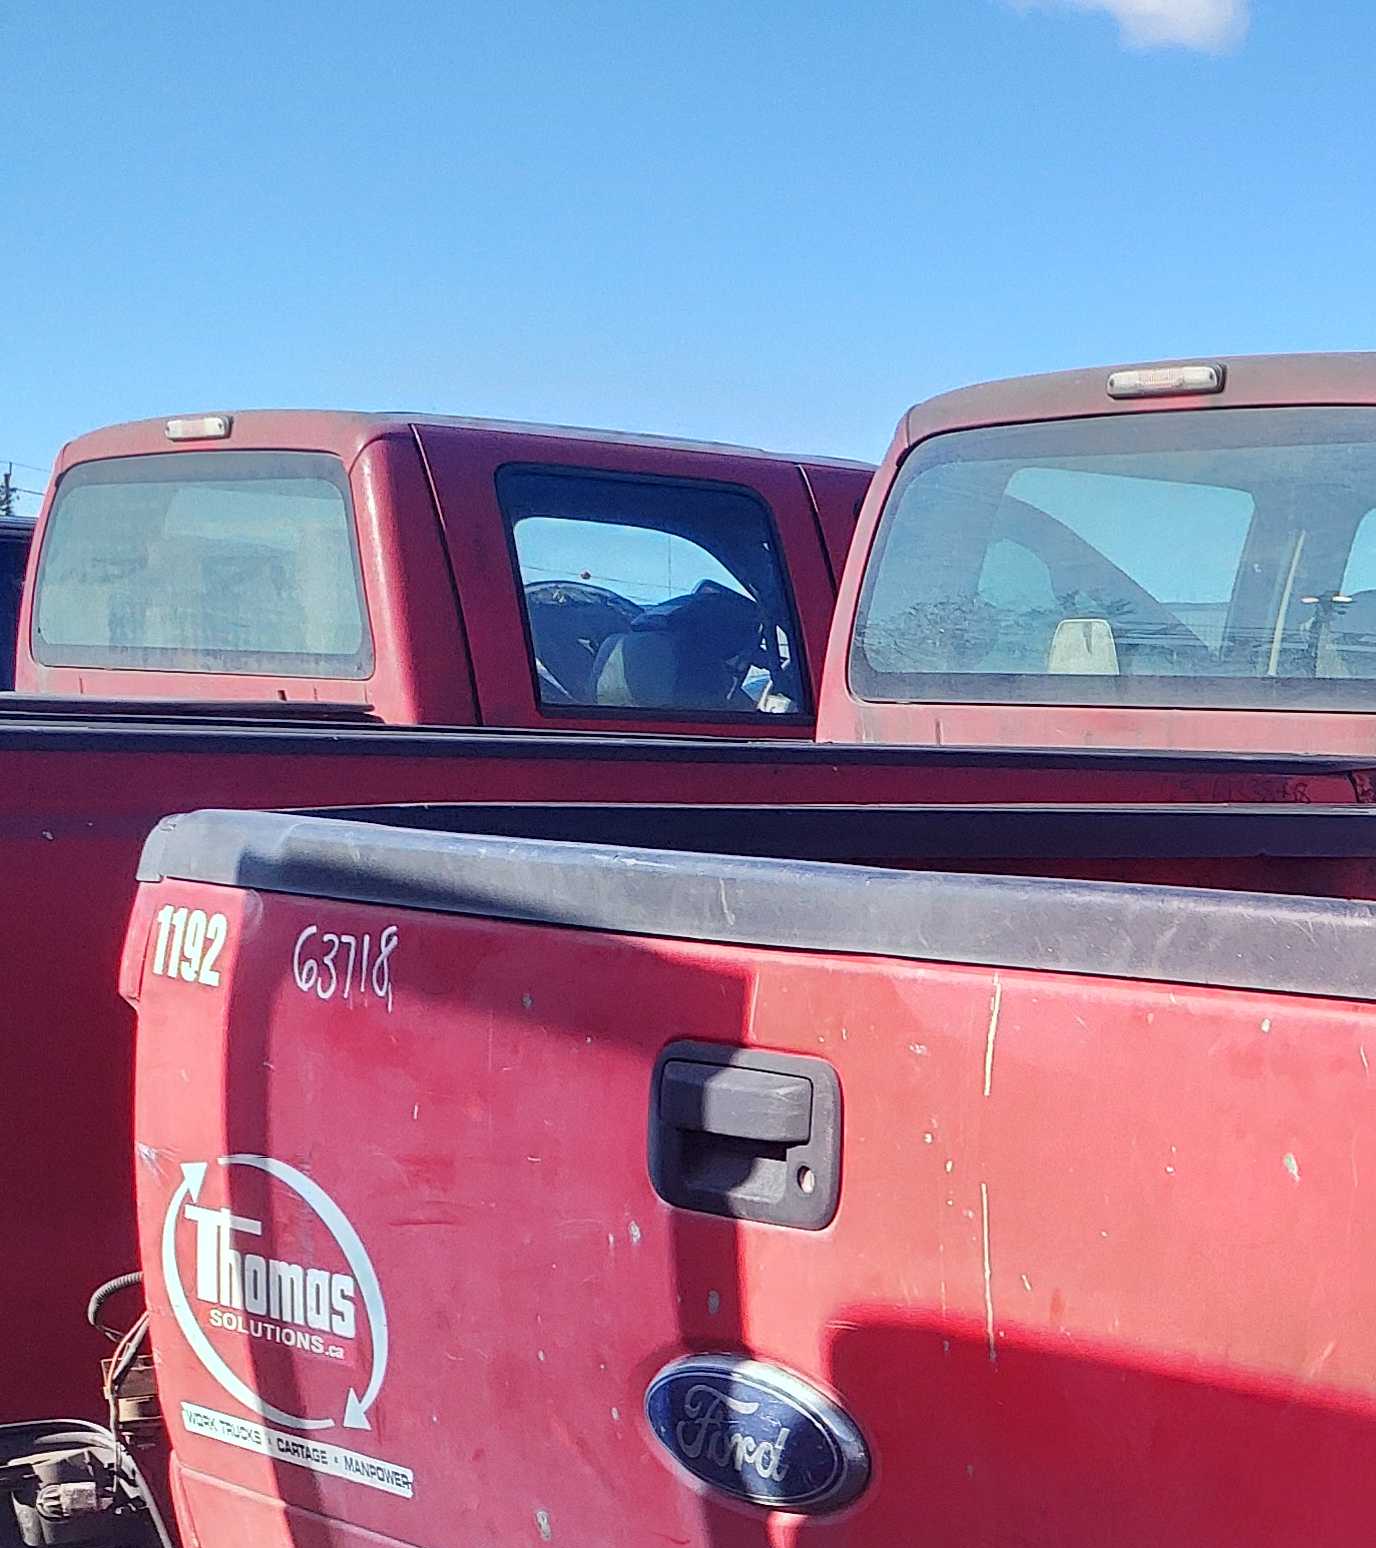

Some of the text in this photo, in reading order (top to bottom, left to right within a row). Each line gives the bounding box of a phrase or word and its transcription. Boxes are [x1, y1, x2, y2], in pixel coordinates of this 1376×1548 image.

[152, 903, 228, 988] 1192
[293, 924, 399, 1013] 63718
[184, 1203, 356, 1339] Thomas
[219, 1418, 262, 1446] TRUCKS
[276, 1436, 329, 1466] CARTAGE
[344, 1455, 412, 1490] MANPOWER
[677, 1384, 792, 1482] Ford
